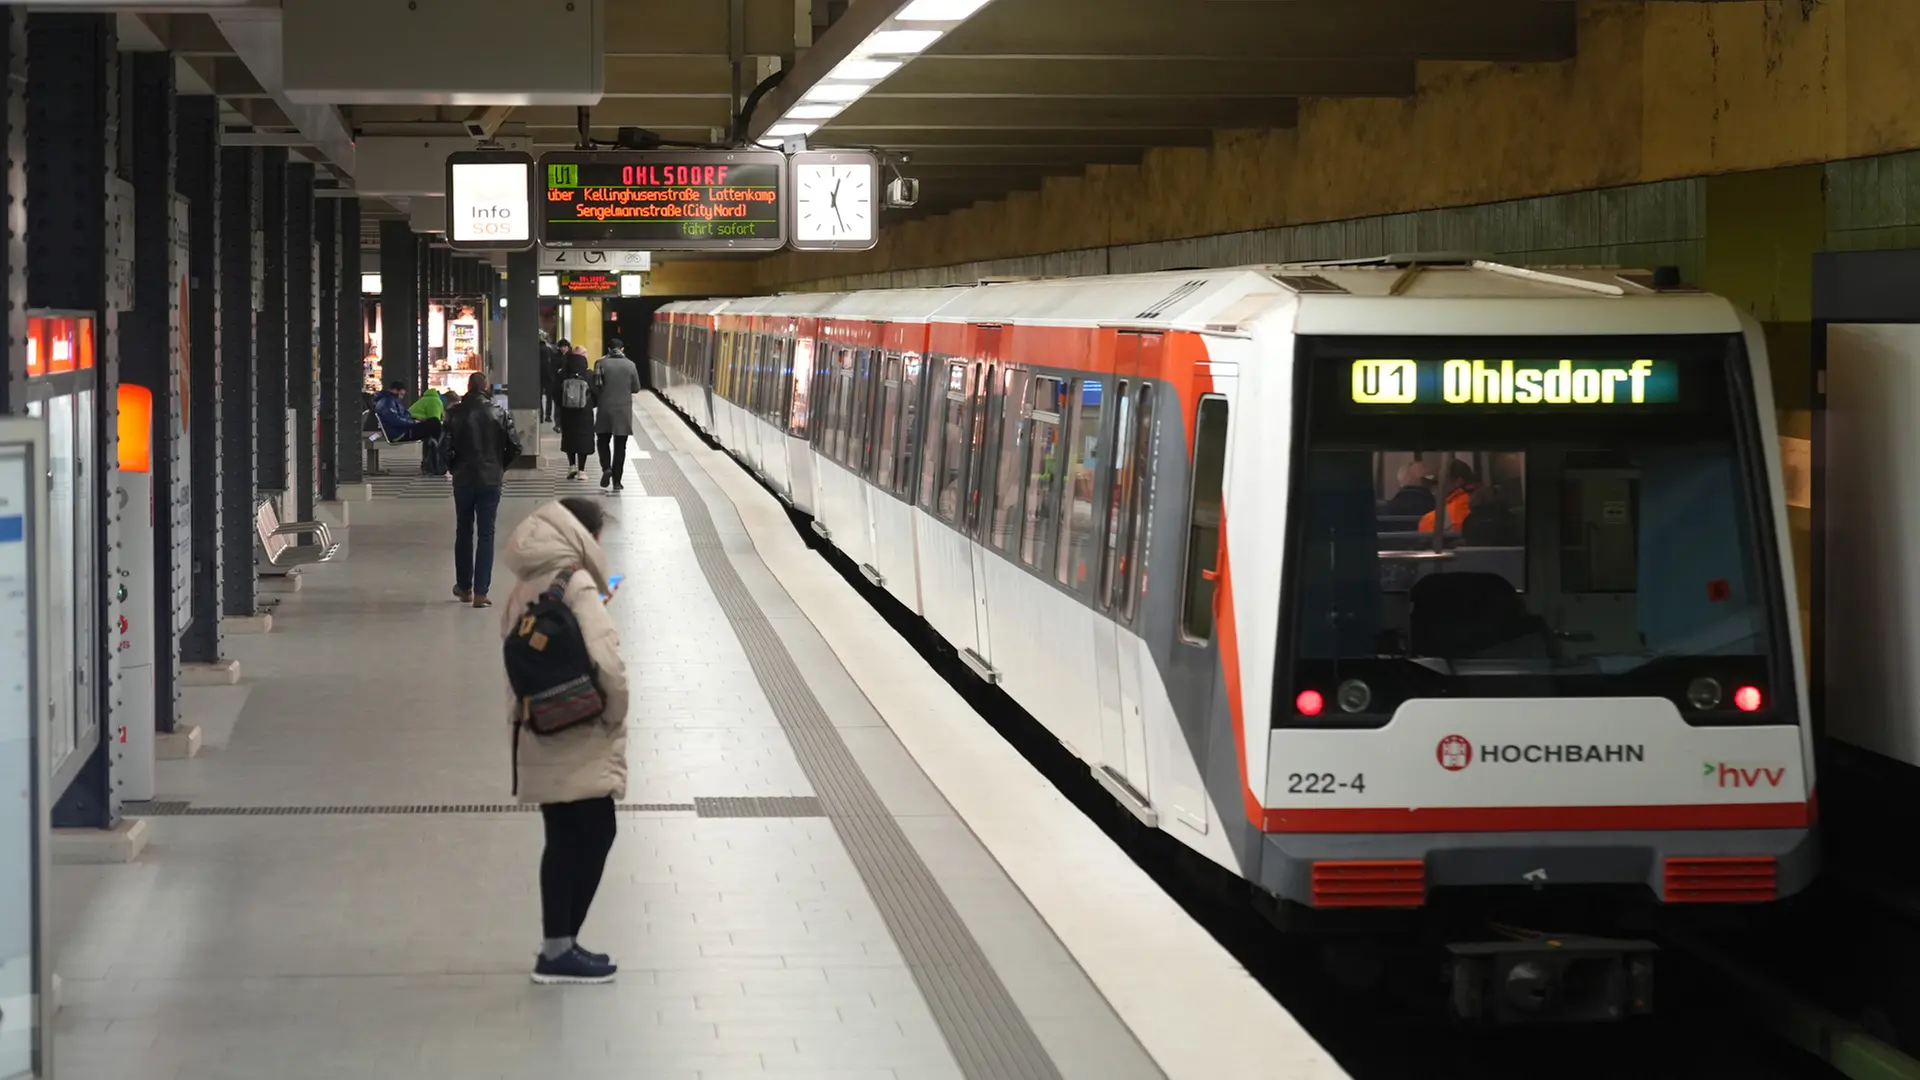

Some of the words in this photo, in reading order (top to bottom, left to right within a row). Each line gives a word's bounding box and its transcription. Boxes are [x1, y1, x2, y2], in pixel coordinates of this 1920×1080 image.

[555, 166, 572, 185] U1
[622, 165, 729, 186] OHLSDORF
[548, 188, 575, 202] über
[584, 188, 700, 204] Kellinghusenstraße
[709, 188, 776, 204] Lattenkamp
[472, 205, 511, 219] Info
[576, 204, 681, 220] Sengelmannstraße
[714, 204, 747, 217] Nord)
[473, 222, 511, 235] SOS
[682, 223, 713, 235] fährt
[717, 223, 755, 235] sofort
[1360, 363, 1407, 398] U1
[1443, 359, 1653, 404] Ohlsdorf
[1480, 743, 1645, 765] HOCHBAHN
[1287, 772, 1366, 795] 222-4
